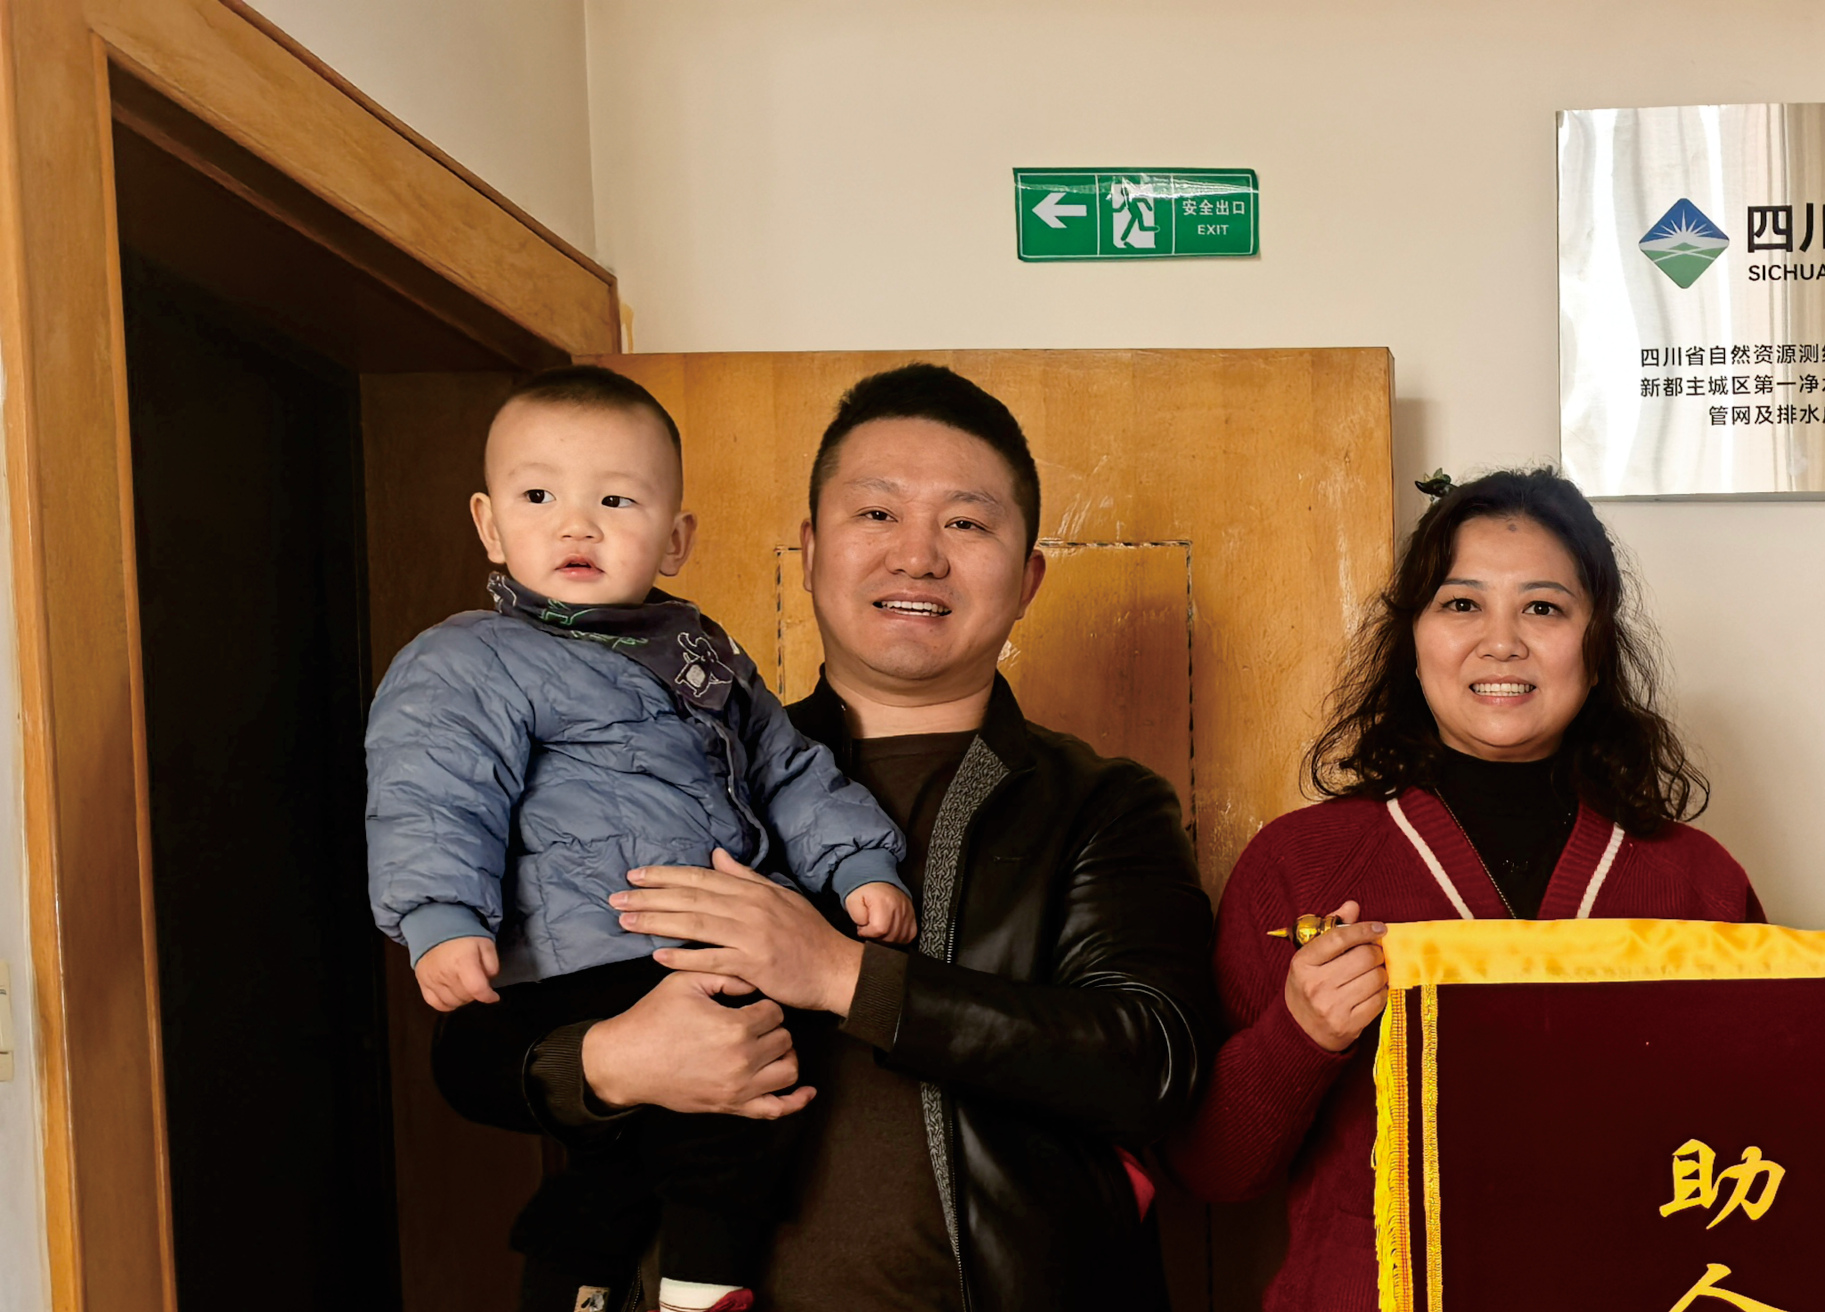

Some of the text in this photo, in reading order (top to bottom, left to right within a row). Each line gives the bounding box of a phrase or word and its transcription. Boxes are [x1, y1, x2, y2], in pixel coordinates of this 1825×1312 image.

[1182, 199, 1245, 216] 安全出口
[1197, 224, 1229, 236] EXIT
